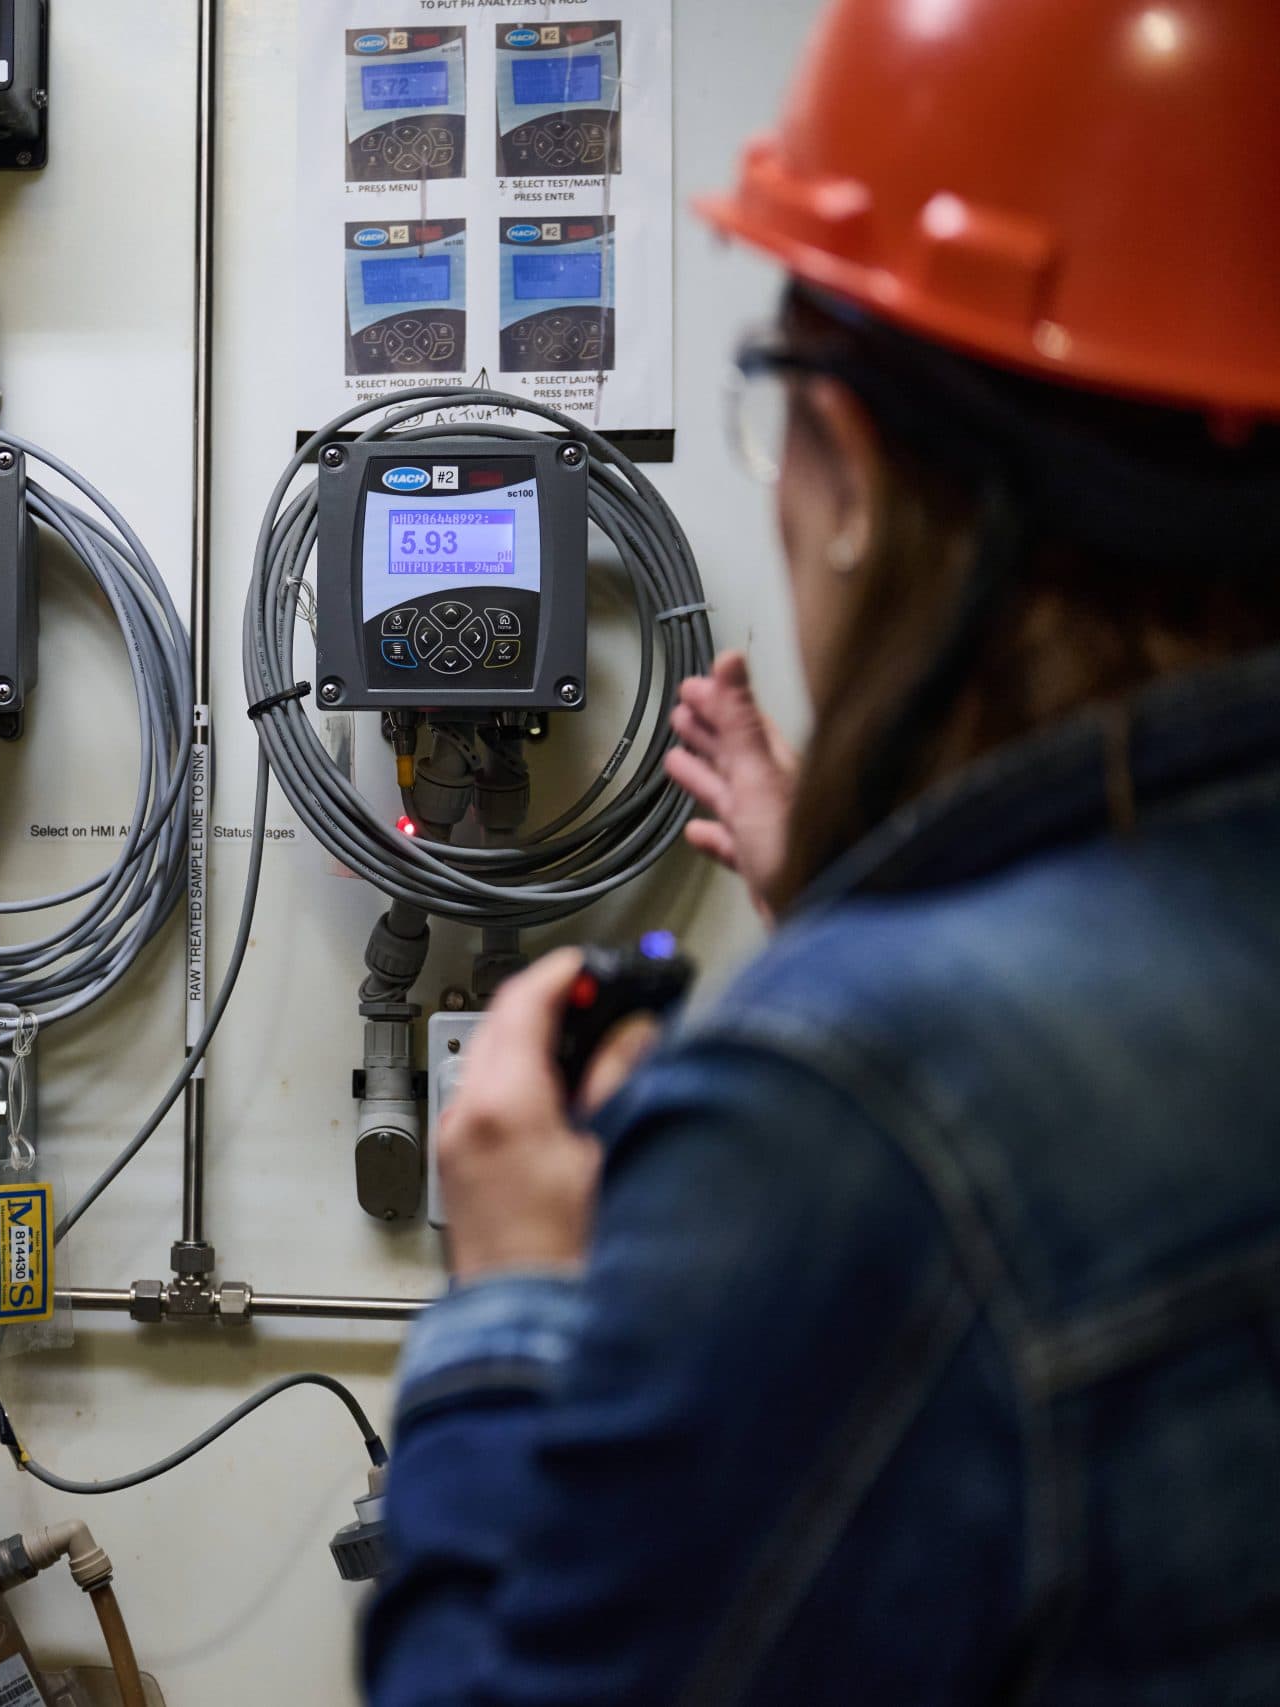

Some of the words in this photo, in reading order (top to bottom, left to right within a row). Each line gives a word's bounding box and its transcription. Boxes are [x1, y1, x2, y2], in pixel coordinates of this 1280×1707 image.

[421, 0, 435, 9] TO
[438, 0, 458, 9] PUT
[358, 184, 386, 193] PRESS
[388, 183, 418, 192] MENU
[512, 179, 545, 189] SELECT
[514, 193, 542, 201] PRESS
[544, 192, 575, 201] ENTER
[545, 227, 558, 237] #2
[355, 379, 387, 389] SELECT
[389, 378, 417, 388] HOLD
[417, 377, 463, 387] OUTPUTS
[535, 376, 567, 385] SELECT
[533, 389, 562, 398] PRESS
[564, 388, 594, 397] ENTER
[564, 402, 594, 411] HOME
[388, 473, 425, 483] HACH
[437, 470, 454, 484] #2
[507, 489, 534, 498] sc100
[400, 530, 458, 554] 5.93
[497, 550, 512, 561] pH
[192, 750, 204, 782] SINK
[192, 785, 204, 805] TO
[192, 808, 203, 839] LINE
[30, 825, 68, 837] Select
[72, 827, 87, 837] on
[91, 825, 115, 837] HMI
[213, 825, 253, 838] Status
[265, 828, 296, 840] ages
[191, 843, 203, 898] SAMPLE
[190, 902, 202, 965] TREATED
[189, 969, 201, 1001] RAW
[7, 1199, 35, 1308] MS
[14, 1230, 26, 1280] 814430
